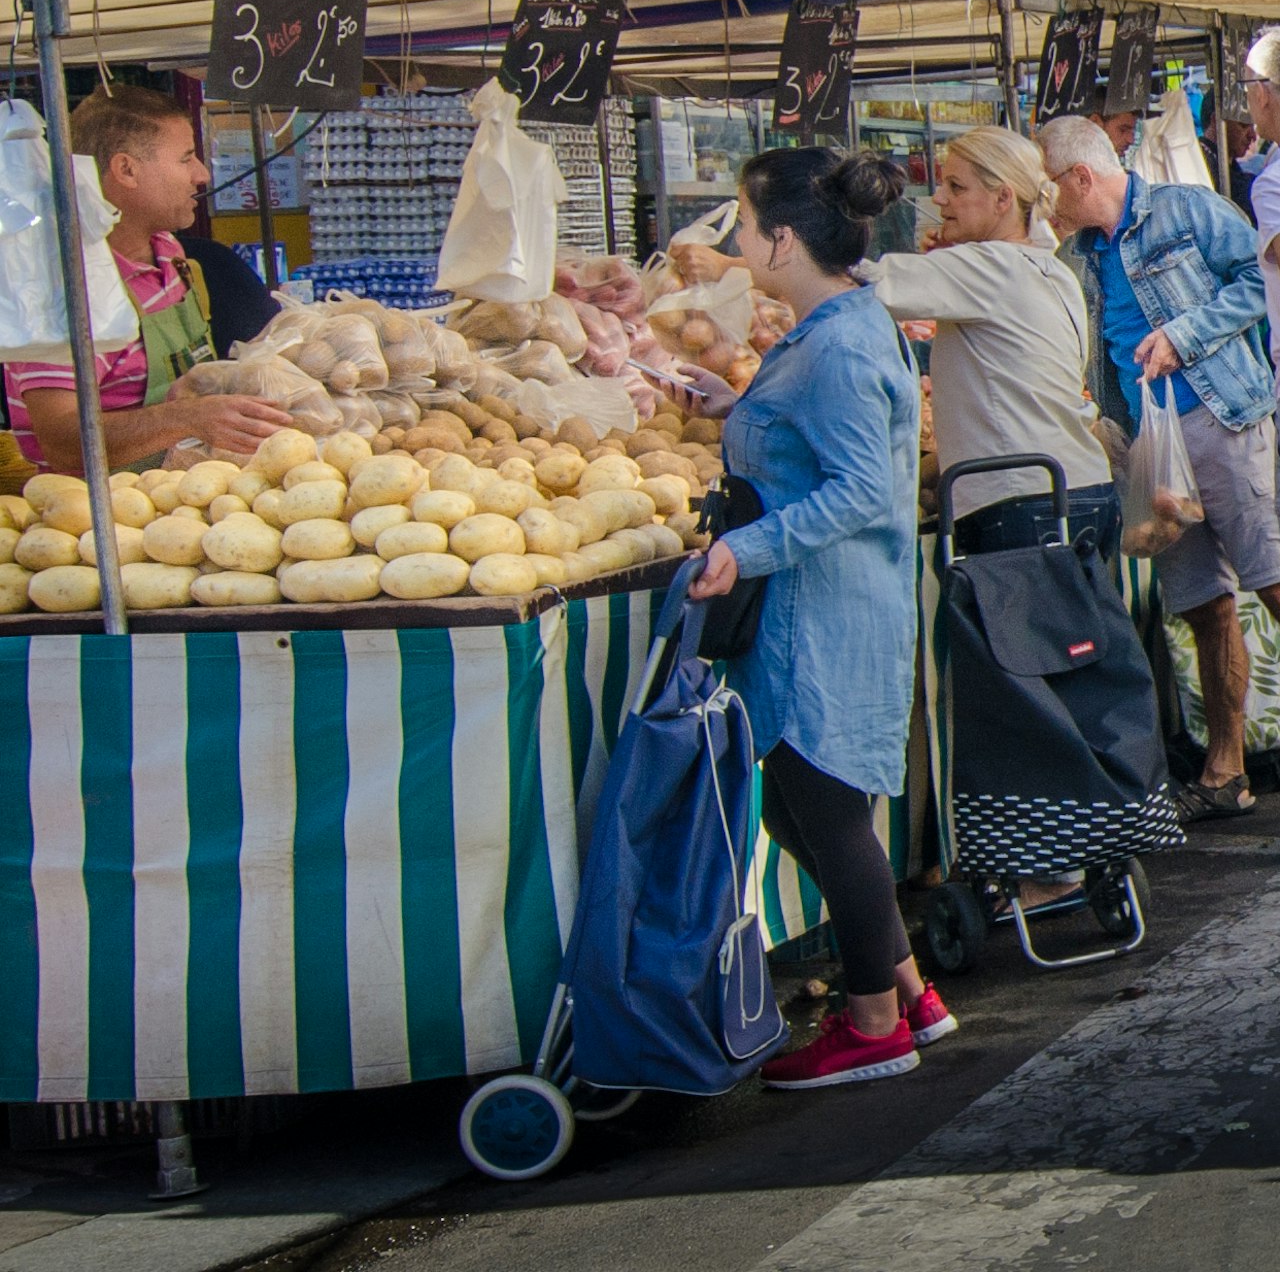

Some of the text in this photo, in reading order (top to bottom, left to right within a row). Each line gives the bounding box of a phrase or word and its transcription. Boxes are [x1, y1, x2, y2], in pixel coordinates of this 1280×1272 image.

[232, 4, 264, 89] 3
[519, 42, 544, 108] 3
[780, 66, 802, 115] 3
